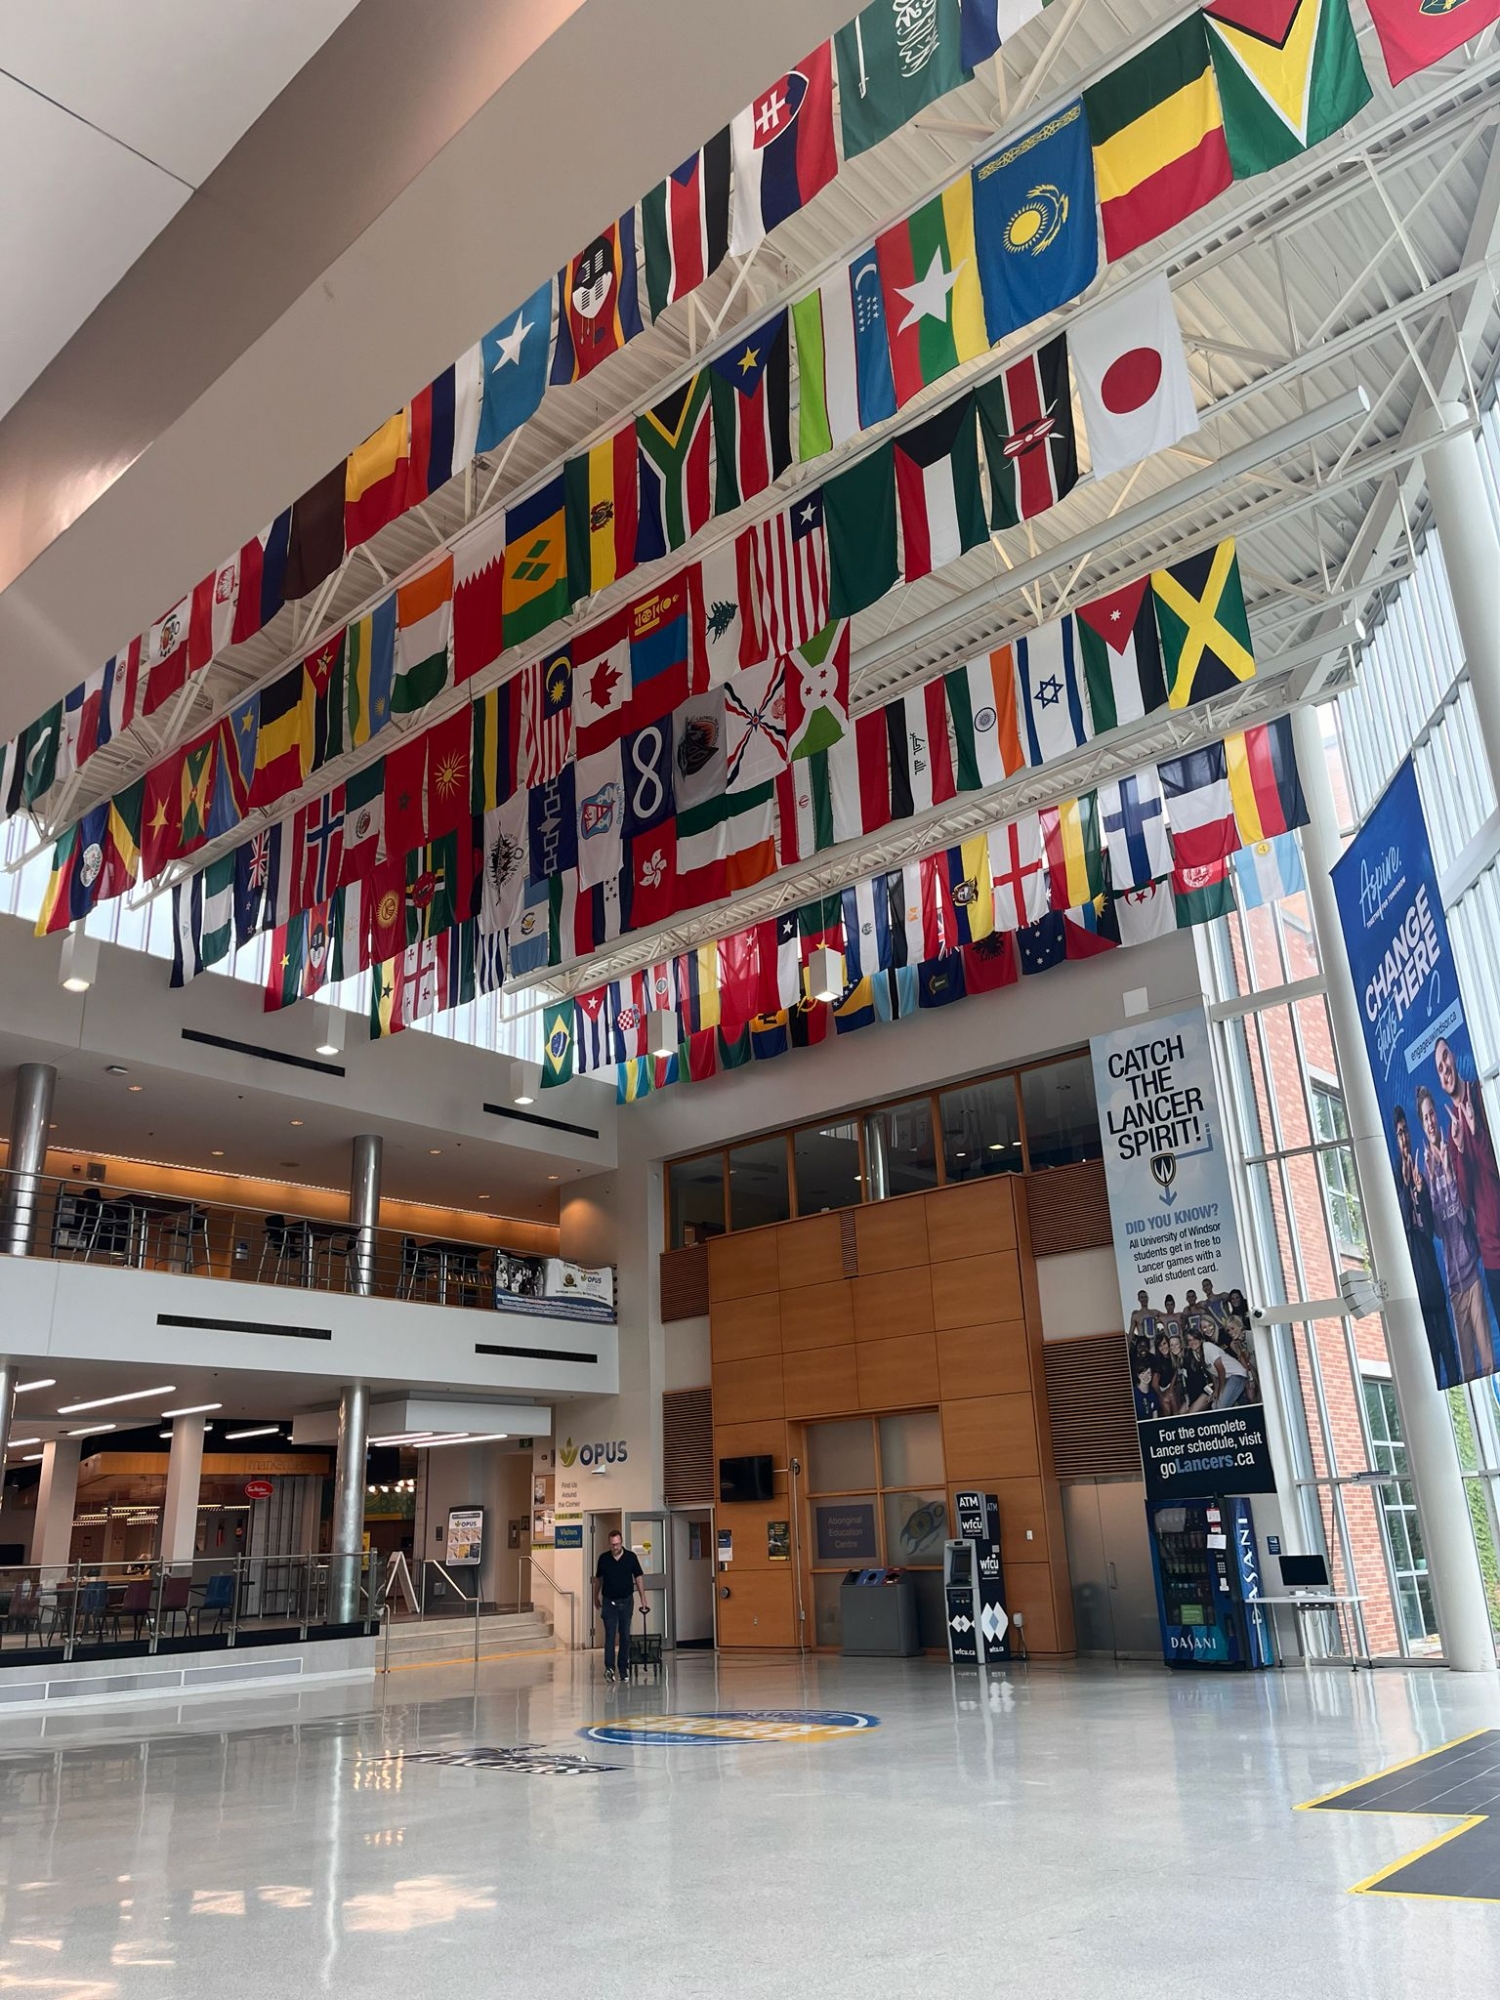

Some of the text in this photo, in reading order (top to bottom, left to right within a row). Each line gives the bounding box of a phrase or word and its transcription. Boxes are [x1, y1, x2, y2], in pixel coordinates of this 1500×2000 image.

[1365, 882, 1433, 1022] CHANGE
[1392, 920, 1440, 1021] HERE
[1410, 1010, 1457, 1062] engageuwindsor.ca
[1108, 1034, 1185, 1079] CATCH
[1126, 1066, 1174, 1100] THE
[1107, 1087, 1204, 1135] LANCER
[1118, 1116, 1202, 1160] SPIRIT!
[1125, 1203, 1219, 1236] DID YOU KNOW?
[1129, 1222, 1222, 1250] All University of Windsor
[1134, 1235, 1222, 1262] students get in free to
[1138, 1250, 1222, 1274] Lancer games with a
[1144, 1262, 1219, 1286] valid student card.
[587, 1276, 602, 1284] OPUS
[1158, 1419, 1246, 1442] For the complete
[580, 1440, 628, 1466] OPUS
[1150, 1431, 1262, 1459] Lancer schedule, visit
[1160, 1451, 1255, 1480] goLancers.ca
[959, 1496, 978, 1508] ATM
[986, 1502, 998, 1512] ATM
[828, 1515, 862, 1526] Aboriginal
[828, 1528, 863, 1537] Education
[962, 1517, 983, 1530] wfcu
[835, 1540, 858, 1549] Centre
[980, 1554, 999, 1570] wfcu
[1238, 1517, 1263, 1625] DASANI
[954, 1648, 976, 1657] wfcu.ca
[989, 1645, 1004, 1654] wfcu.ca
[1170, 1633, 1217, 1651] DASANI
